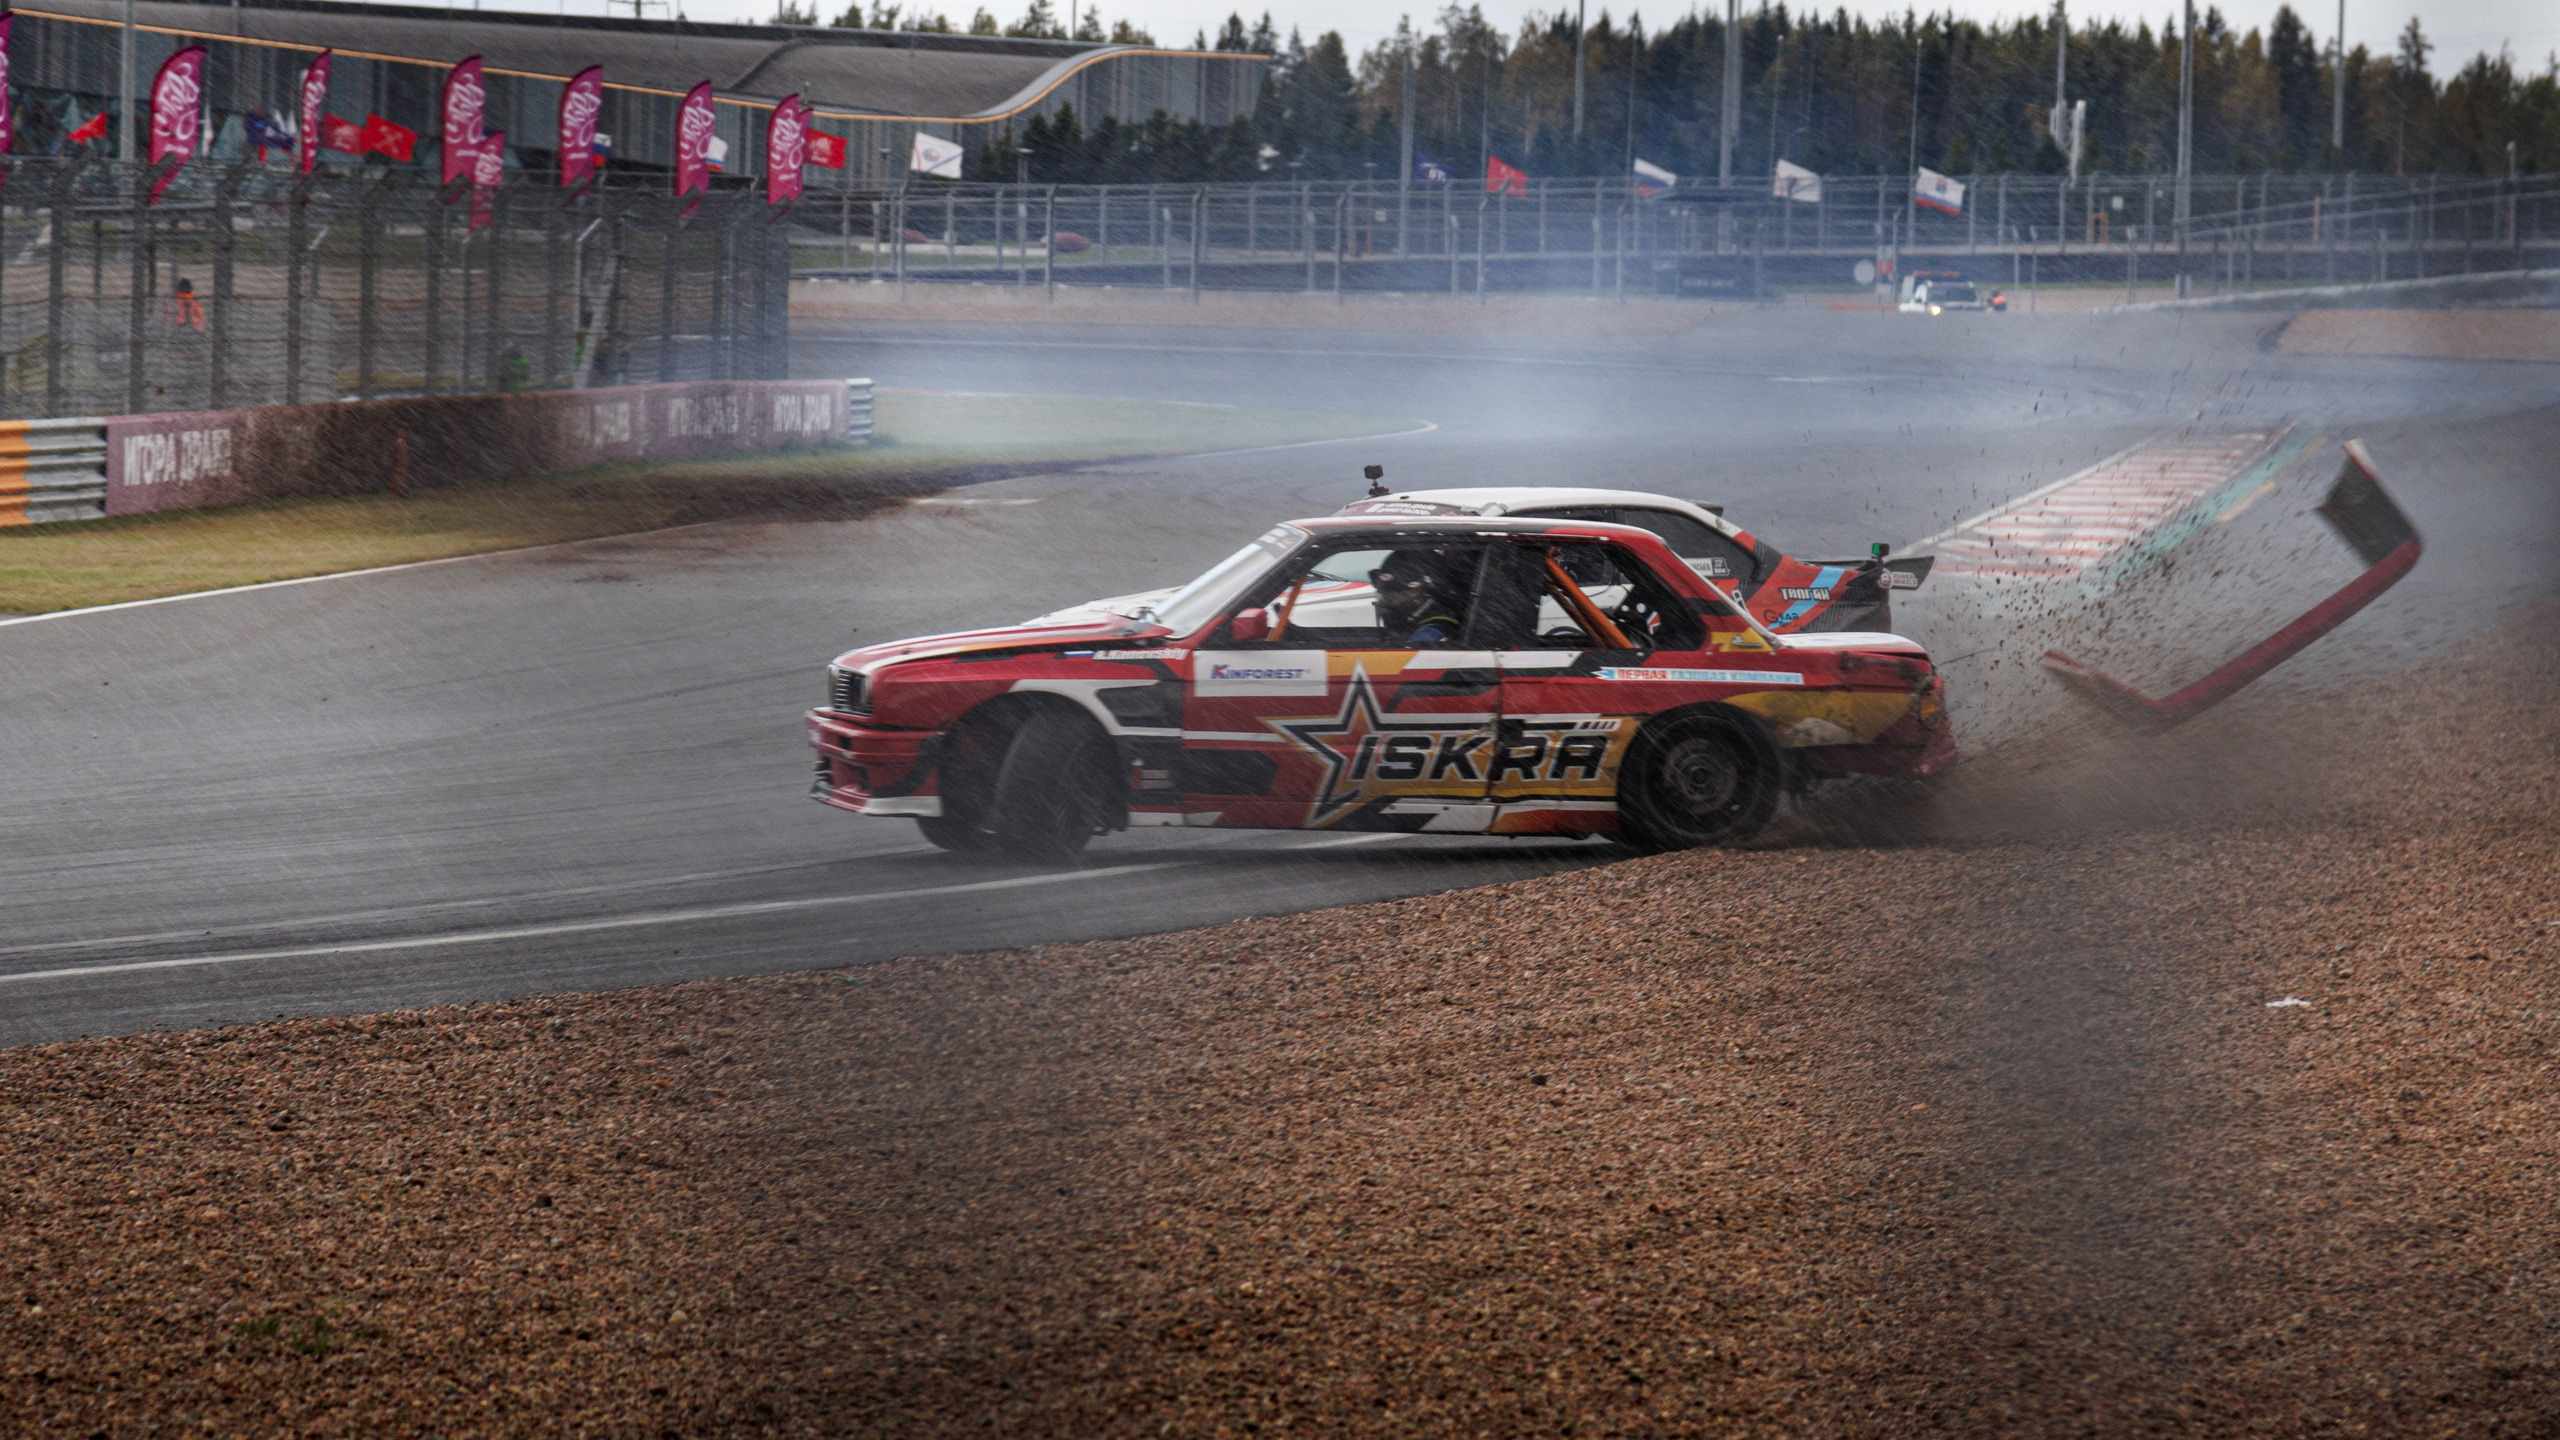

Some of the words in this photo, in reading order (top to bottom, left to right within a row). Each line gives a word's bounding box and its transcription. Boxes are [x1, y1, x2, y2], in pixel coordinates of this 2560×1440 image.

[123, 433, 176, 486] ИГОРА
[1210, 664, 1304, 679] KINFOREST
[1617, 668, 1667, 680] ПЕРВАЯ
[1671, 669, 1726, 682] ГАЗОВАЯ
[1730, 671, 1801, 684] КОМПАНИЯ
[1350, 733, 1609, 781] ISKRA
